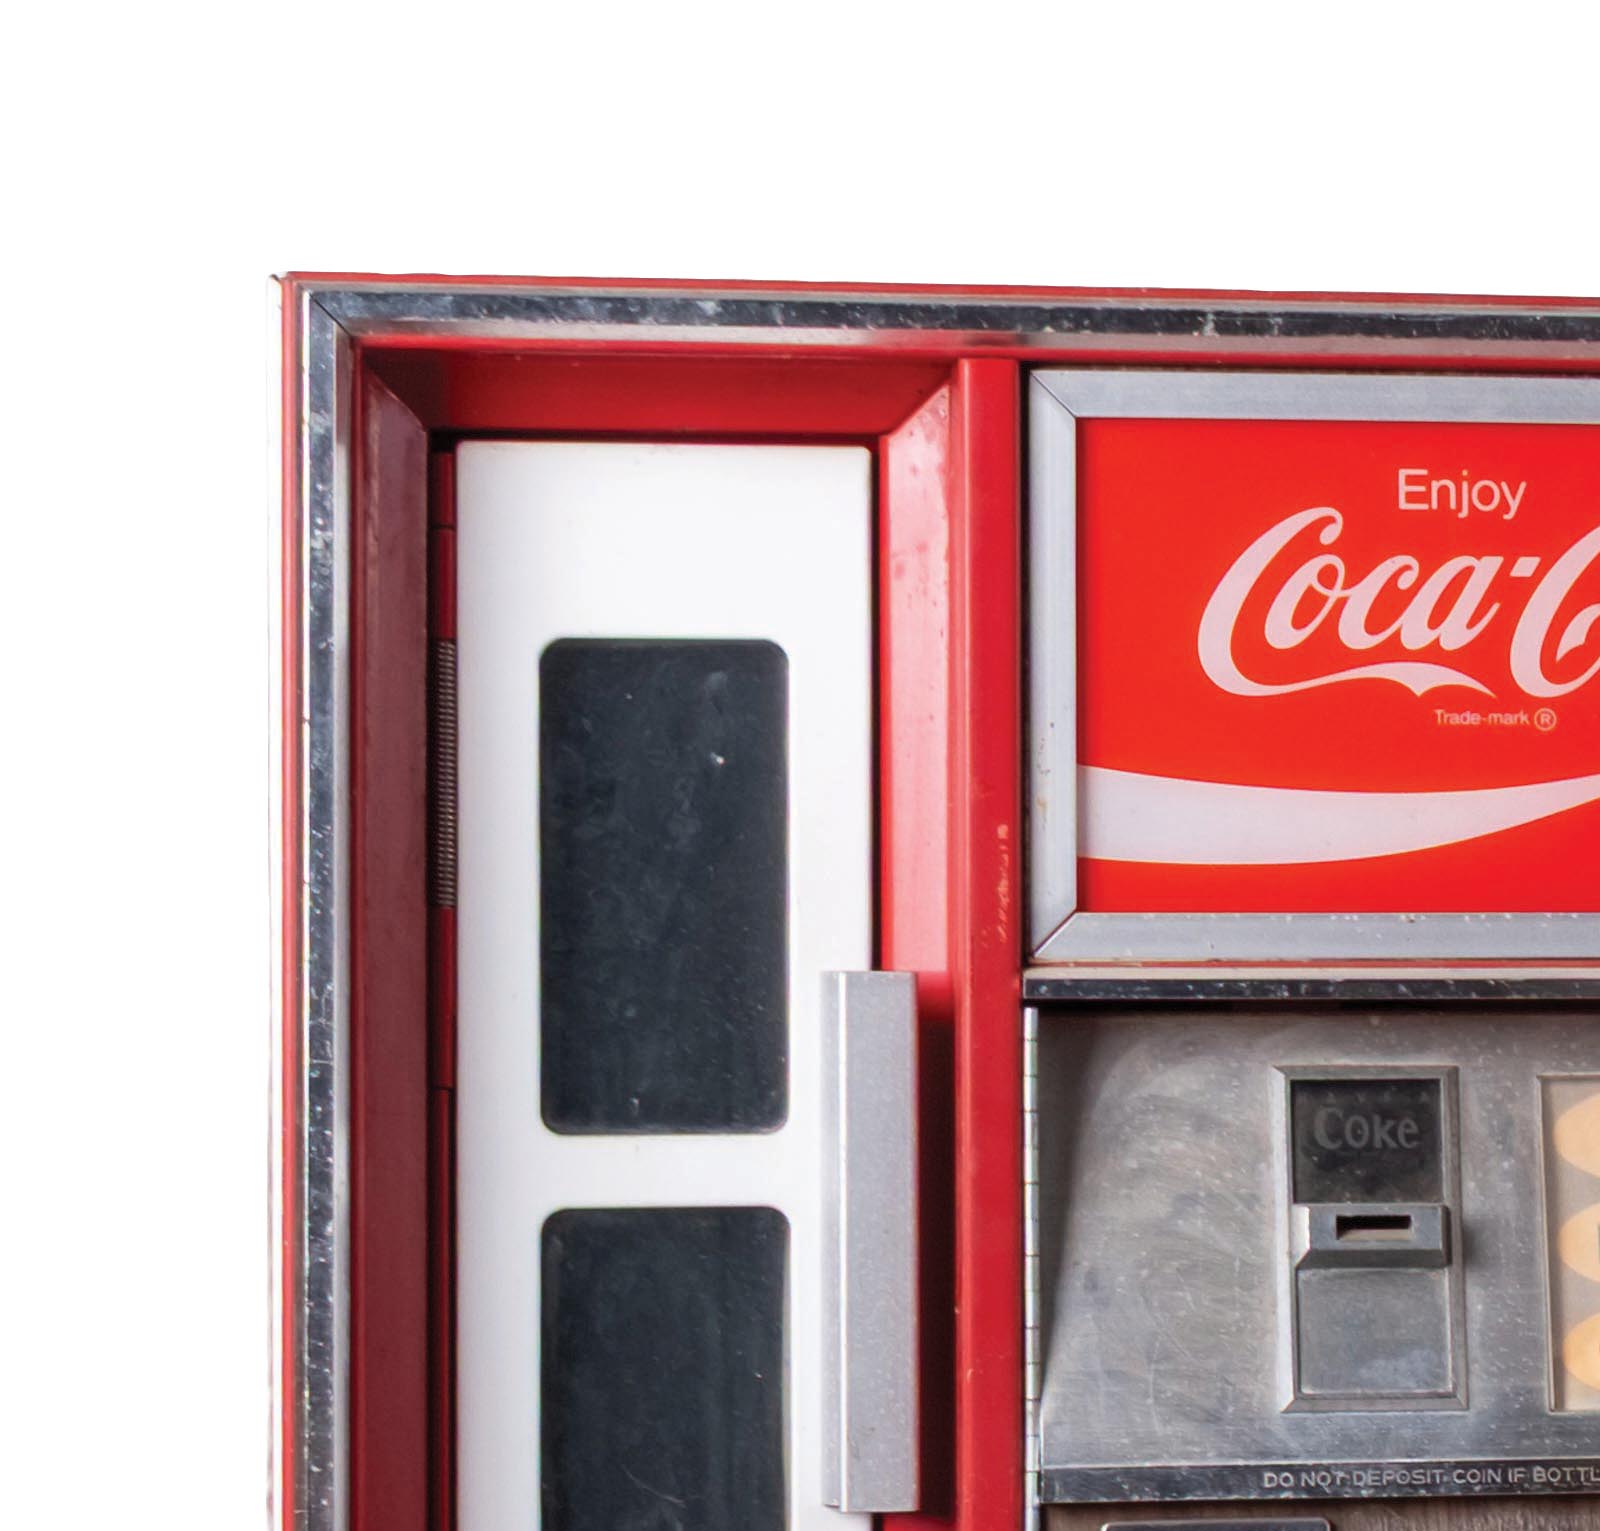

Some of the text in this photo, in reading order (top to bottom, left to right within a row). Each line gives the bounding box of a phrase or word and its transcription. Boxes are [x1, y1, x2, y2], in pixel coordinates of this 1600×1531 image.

[1398, 468, 1527, 520] Enjoy
[1433, 709, 1530, 725] Trade-mark
[1314, 1107, 1421, 1149] Coke
[1263, 1472, 1294, 1488] DO
[1300, 1470, 1344, 1488] NOT
[1352, 1468, 1445, 1487] DEPOSIT
[1453, 1468, 1502, 1485] COIN
[1508, 1467, 1526, 1483] IF
